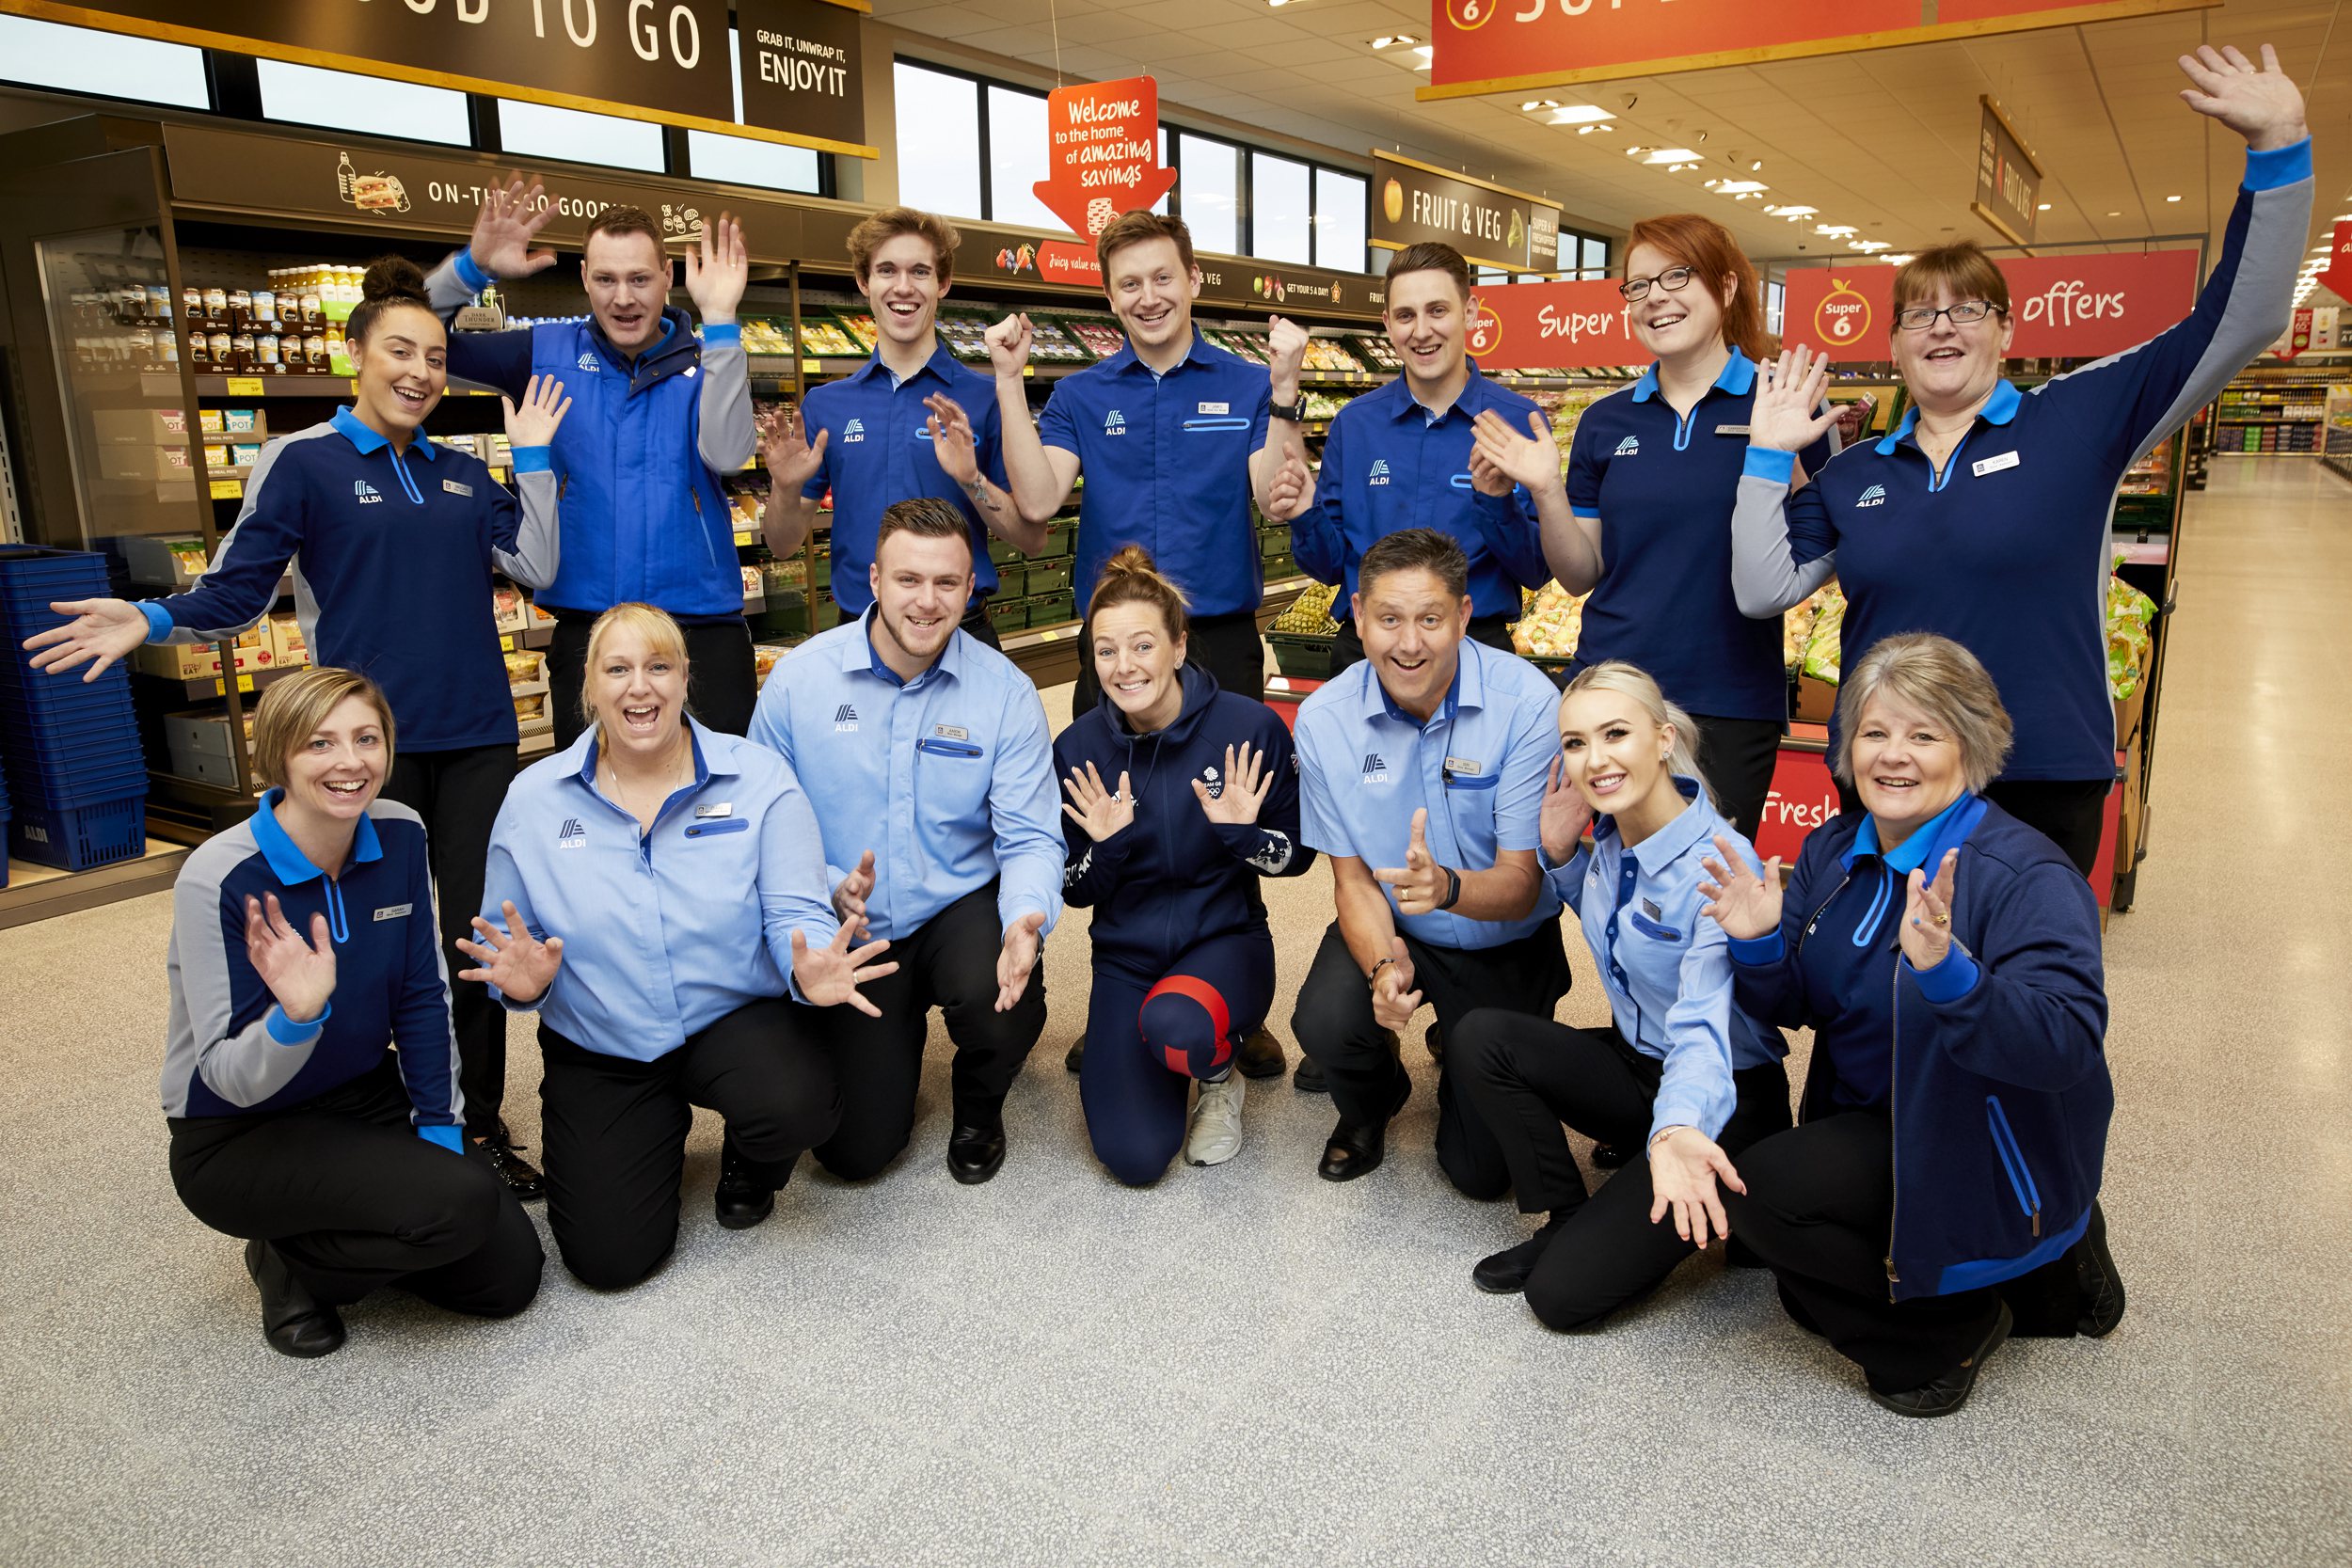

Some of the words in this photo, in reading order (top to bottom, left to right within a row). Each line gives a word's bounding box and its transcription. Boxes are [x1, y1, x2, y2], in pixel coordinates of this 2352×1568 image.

[1463, 0, 1480, 21] 6
[628, 0, 700, 70] GO
[756, 29, 783, 47] GRAB
[785, 36, 795, 52] IT,
[796, 39, 834, 58] UNWRAP
[835, 49, 846, 64] IT,
[759, 50, 826, 92] ENJOY
[829, 67, 847, 97] IT
[1068, 96, 1141, 124] Welcome
[1055, 132, 1068, 144] to
[1069, 128, 1089, 143] the
[1090, 126, 1124, 140] home
[1066, 150, 1078, 165] of
[1080, 137, 1152, 164] amazing
[1081, 163, 1142, 189] savings
[1413, 189, 1457, 231] FRUIT
[1461, 202, 1471, 235] &
[1476, 205, 1501, 242] VEG
[1049, 253, 1069, 271] Juicy
[1071, 256, 1089, 271] value
[1200, 272, 1204, 283] &
[1207, 272, 1221, 286] VEG
[1287, 283, 1296, 293] GET
[1296, 284, 1309, 295] YOUR
[1310, 285, 1313, 294] 5
[1313, 285, 1318, 295] A
[1318, 286, 1329, 297] DAY!
[1824, 301, 1862, 317] Super
[2023, 279, 2125, 327] offers
[463, 314, 495, 323] THUNDER
[1473, 318, 1495, 329] per
[1537, 304, 1613, 344] Super
[1833, 315, 1851, 338] 6
[1471, 329, 1487, 348] 6
[579, 364, 600, 372] ALDI
[167, 421, 180, 430] OT
[201, 421, 217, 430] POT
[1105, 427, 1126, 436] ALDI
[844, 434, 864, 443] ALDI
[1613, 448, 1638, 456] ALDI
[1369, 477, 1390, 485] ALDI
[359, 495, 383, 504] ALDI
[1855, 497, 1885, 508] ALDI
[183, 667, 199, 675] EAT
[834, 723, 859, 732] ALDI
[1363, 774, 1388, 784] ALDI
[1761, 790, 1841, 829] Fresh
[24, 824, 48, 844] ALDI
[559, 838, 586, 849] ALDI
